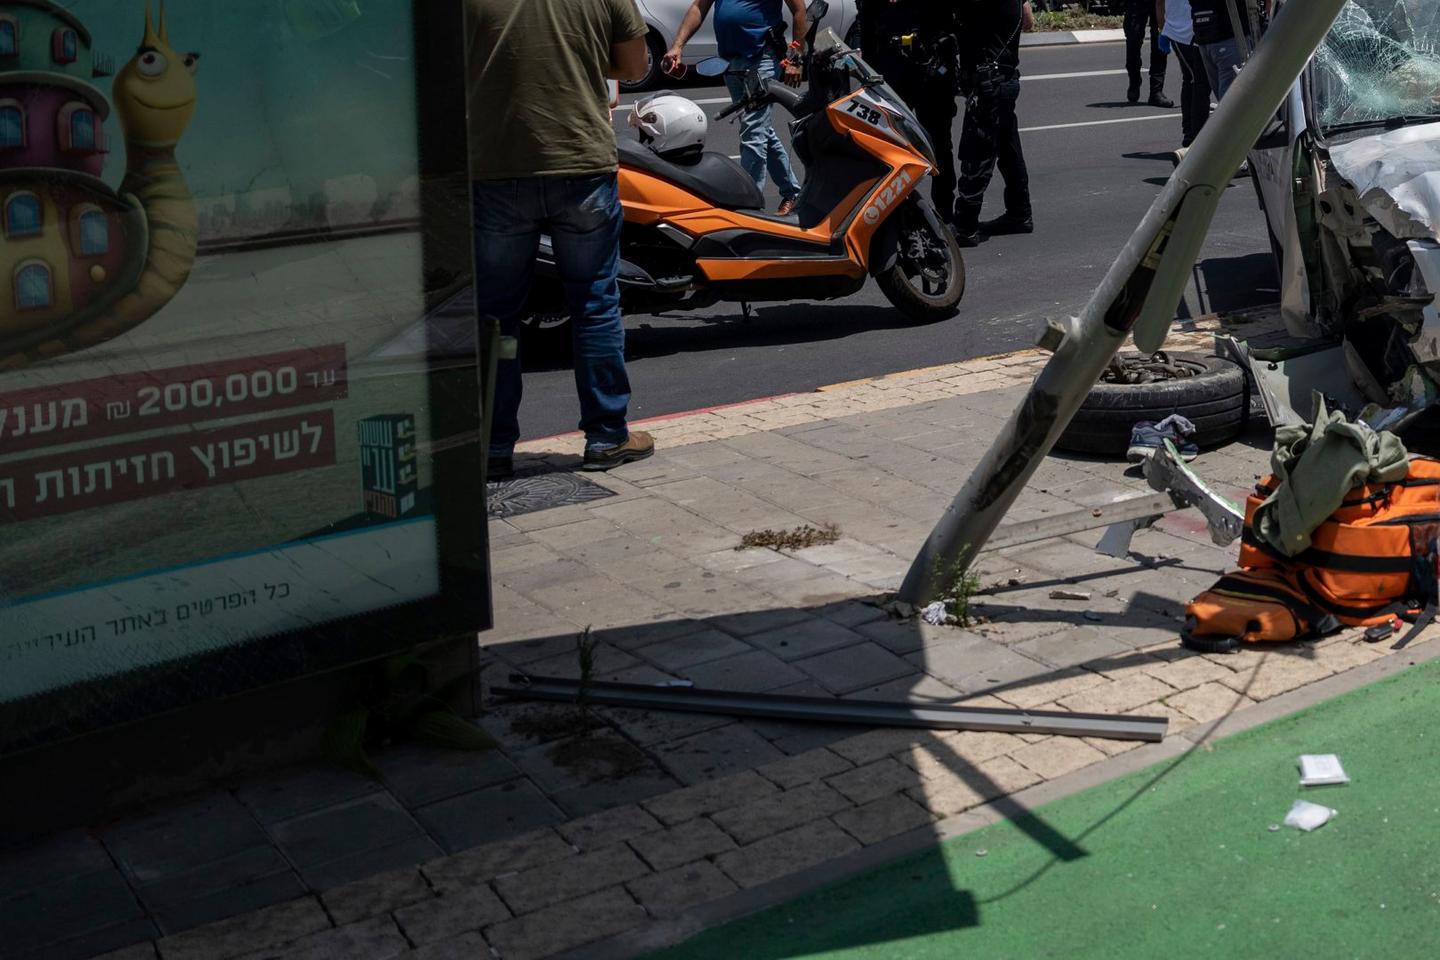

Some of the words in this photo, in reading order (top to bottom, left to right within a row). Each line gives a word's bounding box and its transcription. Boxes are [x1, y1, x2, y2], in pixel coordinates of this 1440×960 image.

[845, 98, 881, 127] 738
[876, 170, 912, 215] 1221
[136, 365, 298, 417] 200,000
[304, 369, 337, 389] עד
[0, 395, 89, 439] מענ
[190, 420, 325, 479] לשיפוץ
[34, 448, 176, 504] חזיתות
[176, 588, 257, 622] הפרטים
[264, 581, 291, 600] כל
[105, 608, 170, 637] באתר
